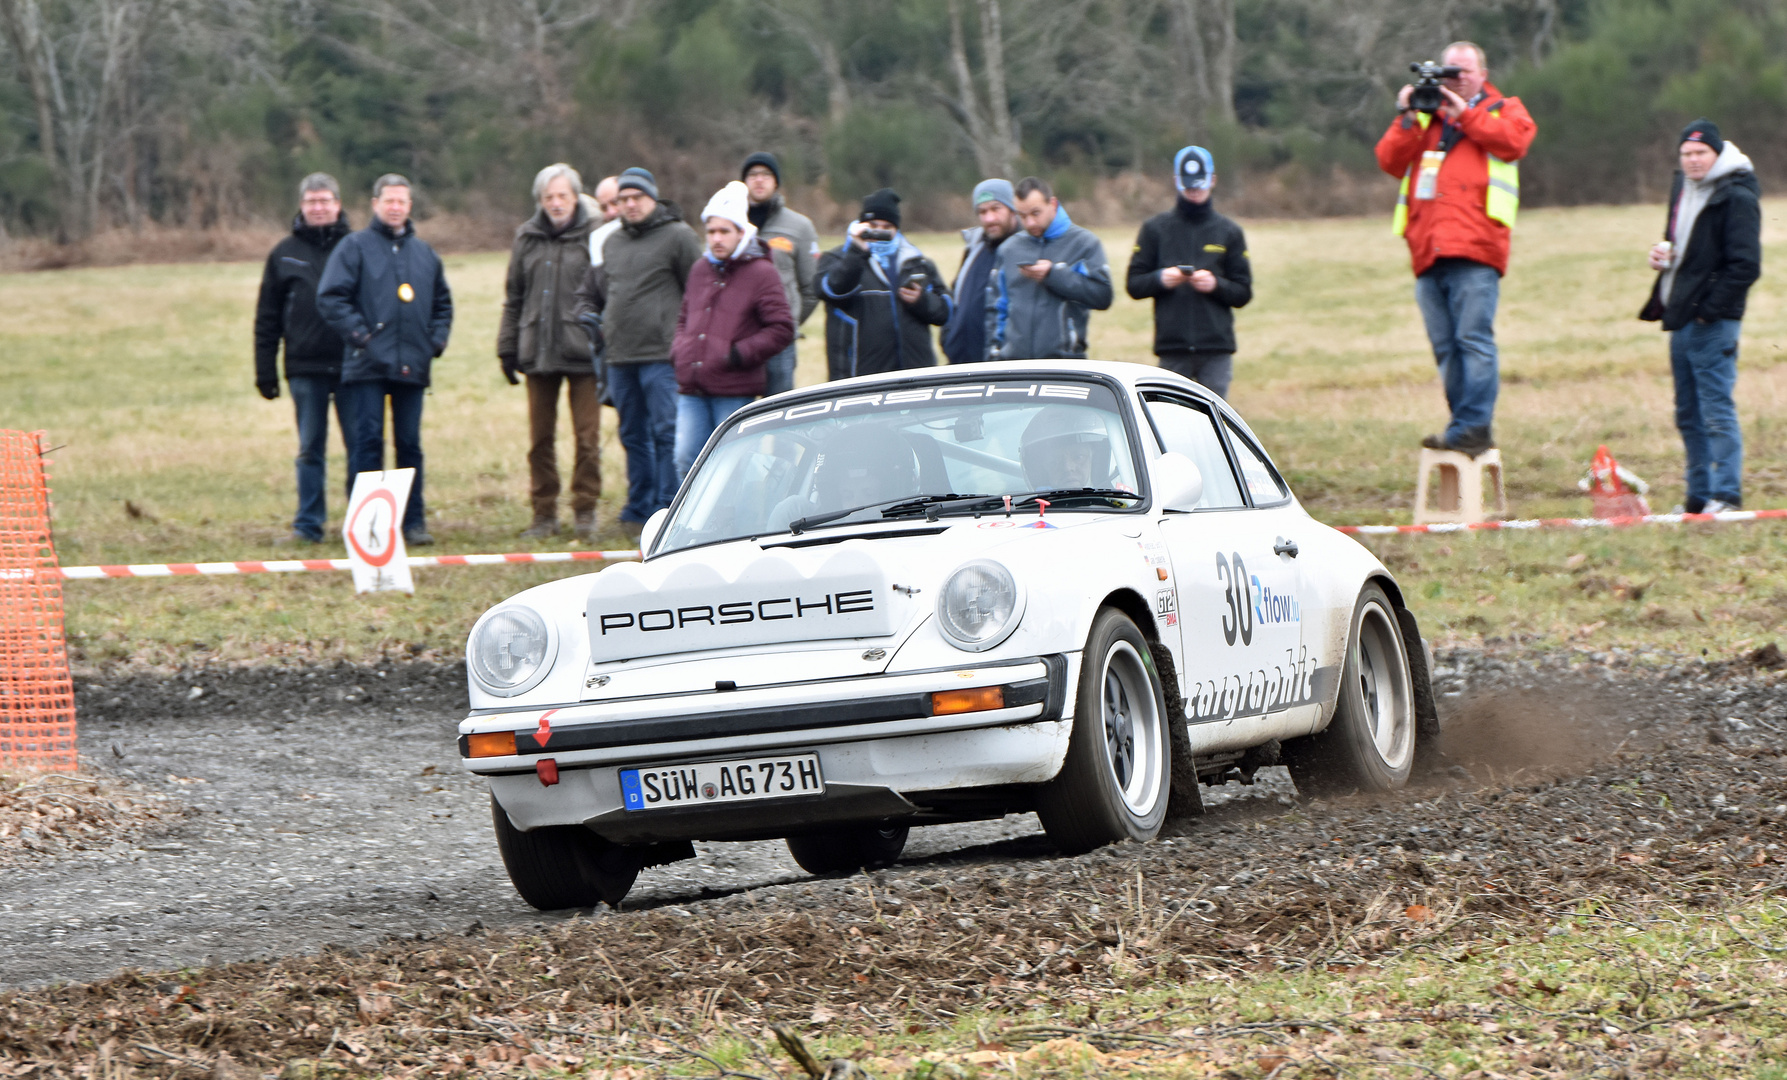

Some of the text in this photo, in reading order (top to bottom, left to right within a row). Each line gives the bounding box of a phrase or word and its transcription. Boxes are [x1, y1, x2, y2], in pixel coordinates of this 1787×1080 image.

[737, 384, 1090, 434] PORSCHE
[600, 589, 874, 635] PORSCHE
[1216, 551, 1253, 646] 30
[630, 793, 638, 803] D
[643, 769, 698, 802] SÜW
